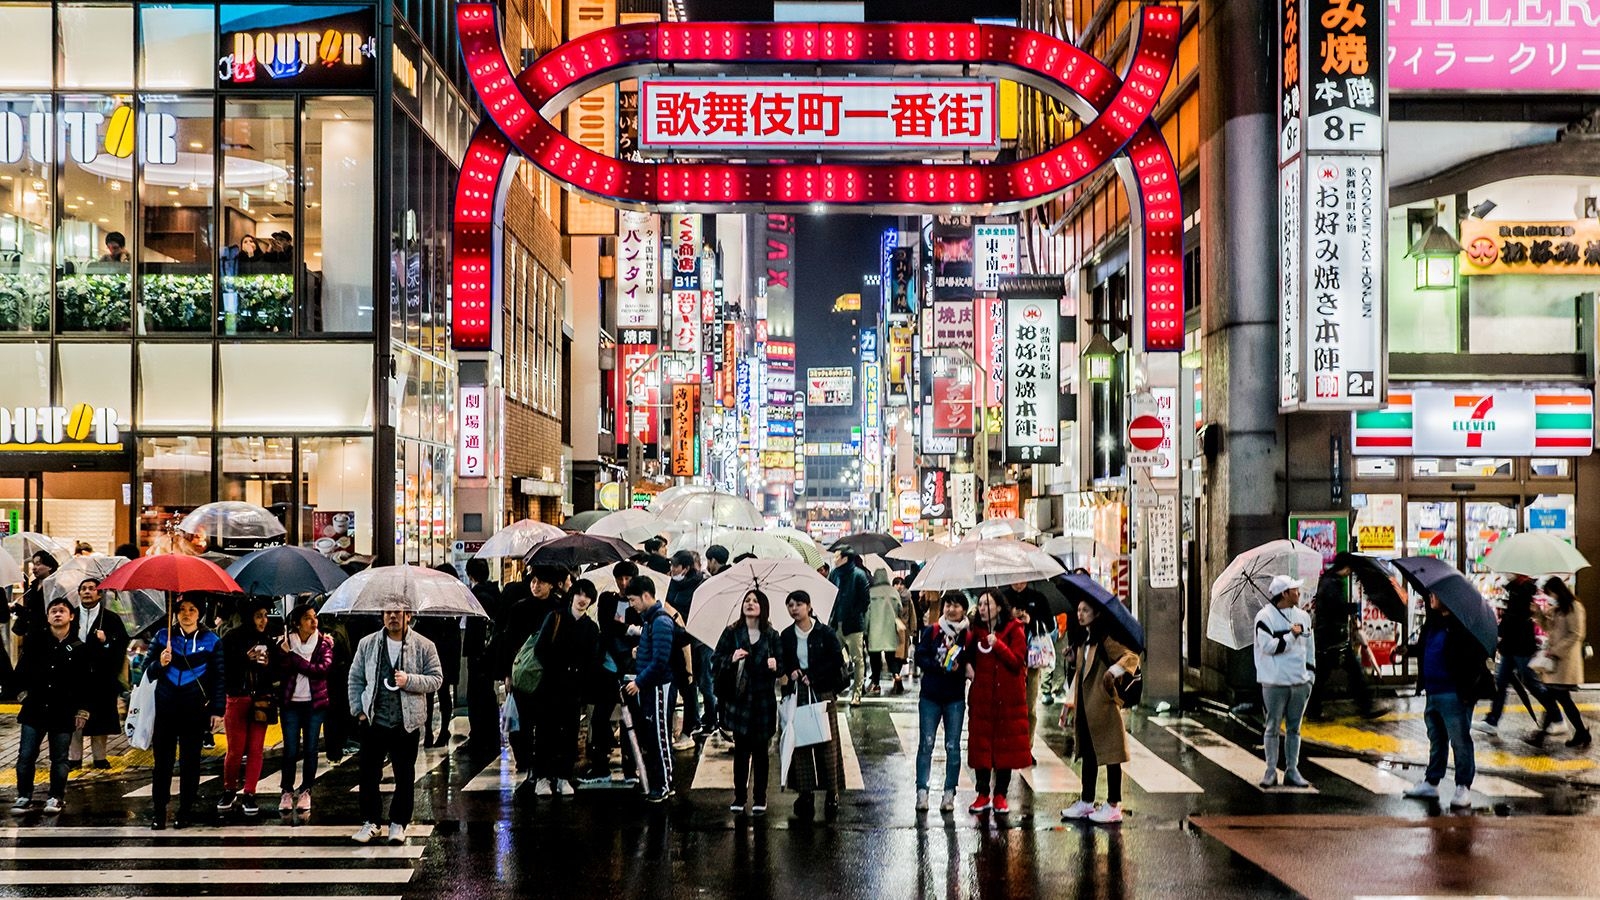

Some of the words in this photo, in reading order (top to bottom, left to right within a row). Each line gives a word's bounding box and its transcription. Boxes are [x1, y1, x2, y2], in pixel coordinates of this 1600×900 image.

[1388, 0, 1600, 27] ILLER
[233, 29, 363, 66] DOUTOR
[1321, 0, 1367, 75] み焼
[1315, 77, 1375, 108] 本陣
[655, 91, 984, 137] 歌舞伎町一番街
[1323, 116, 1366, 141] 8F
[622, 229, 642, 299] バンタイ
[1314, 185, 1340, 372] お好み焼き本陣
[675, 276, 698, 287] B1F
[623, 330, 652, 345] 焼肉
[1015, 324, 1038, 438] お好み焼本陣
[1349, 374, 1373, 394] 2F
[465, 394, 480, 468] 劇場通り
[1021, 446, 1042, 460] 2F
